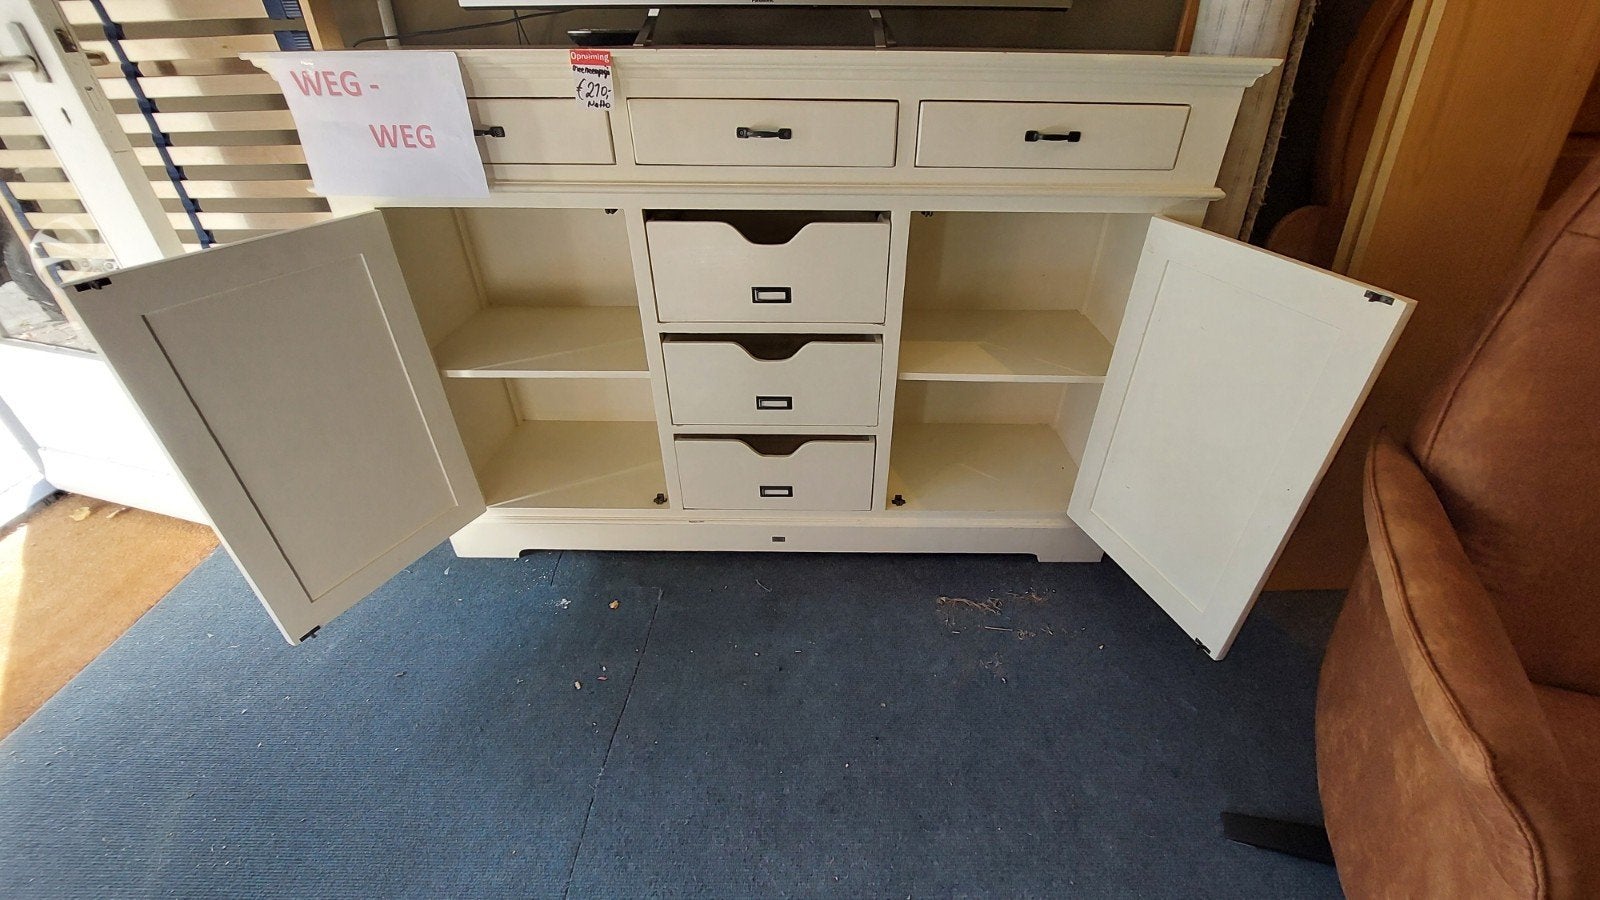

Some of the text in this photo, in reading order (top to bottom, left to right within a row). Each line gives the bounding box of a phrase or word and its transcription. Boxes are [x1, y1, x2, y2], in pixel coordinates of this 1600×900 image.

[570, 51, 610, 63] Opruiming
[290, 70, 363, 96] WEG
[369, 124, 437, 149] WEG
